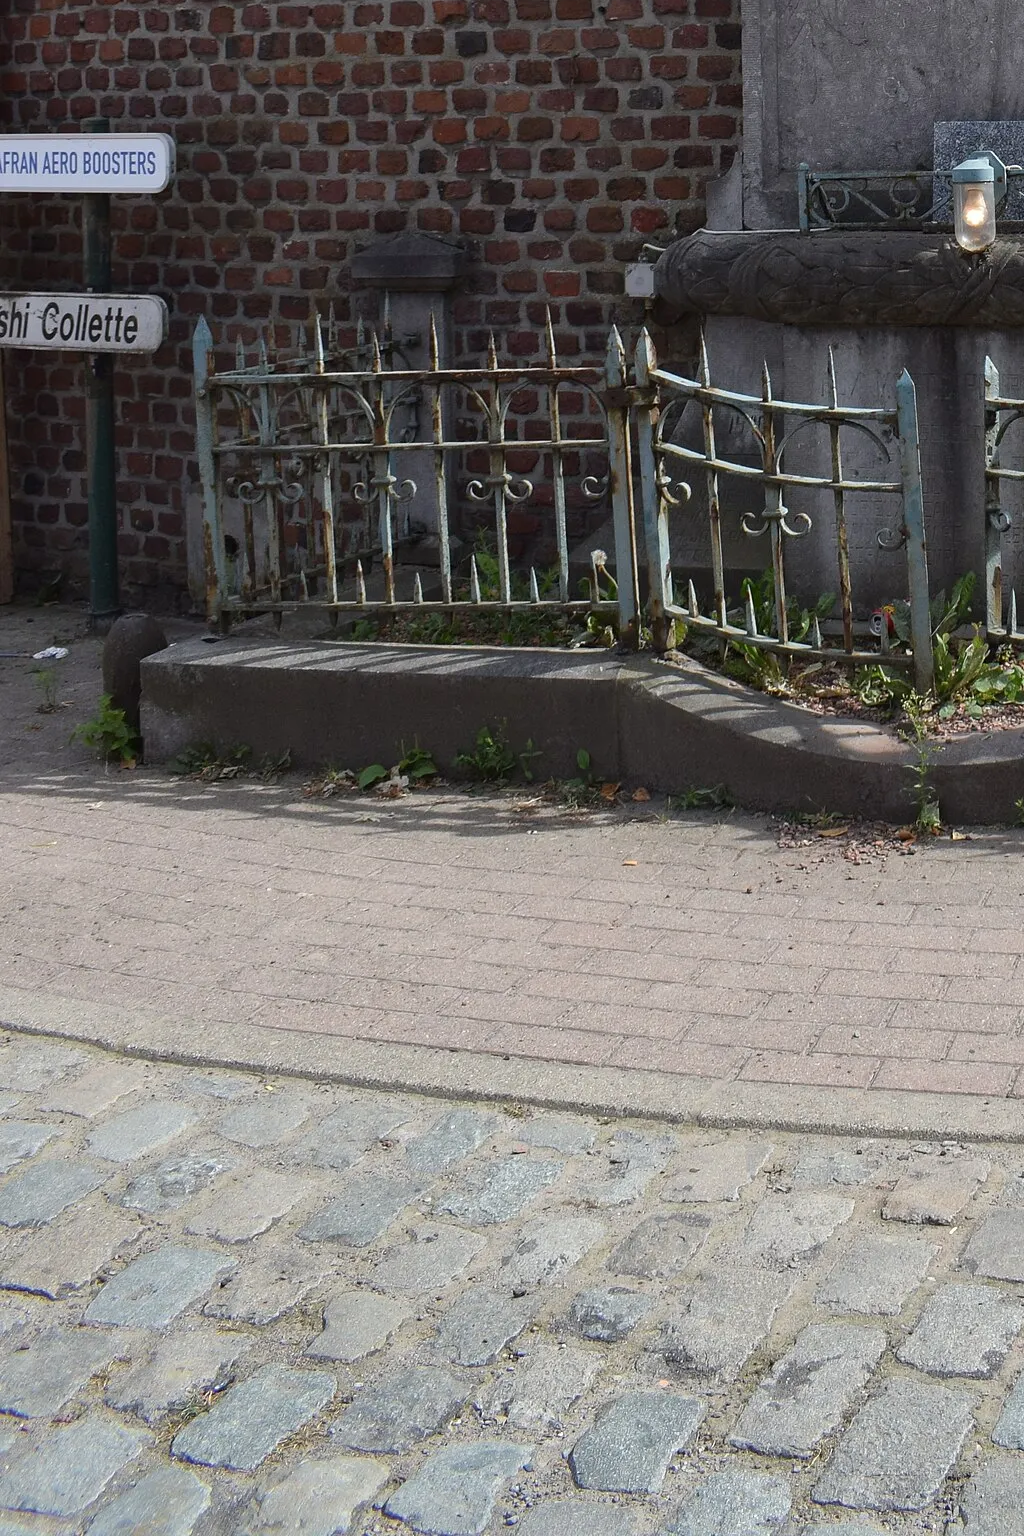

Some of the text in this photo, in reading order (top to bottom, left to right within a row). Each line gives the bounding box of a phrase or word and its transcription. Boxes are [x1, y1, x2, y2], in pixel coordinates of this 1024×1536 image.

[42, 152, 78, 174] AERO
[84, 152, 156, 175] BOOSTERS
[41, 302, 138, 343] Collette
